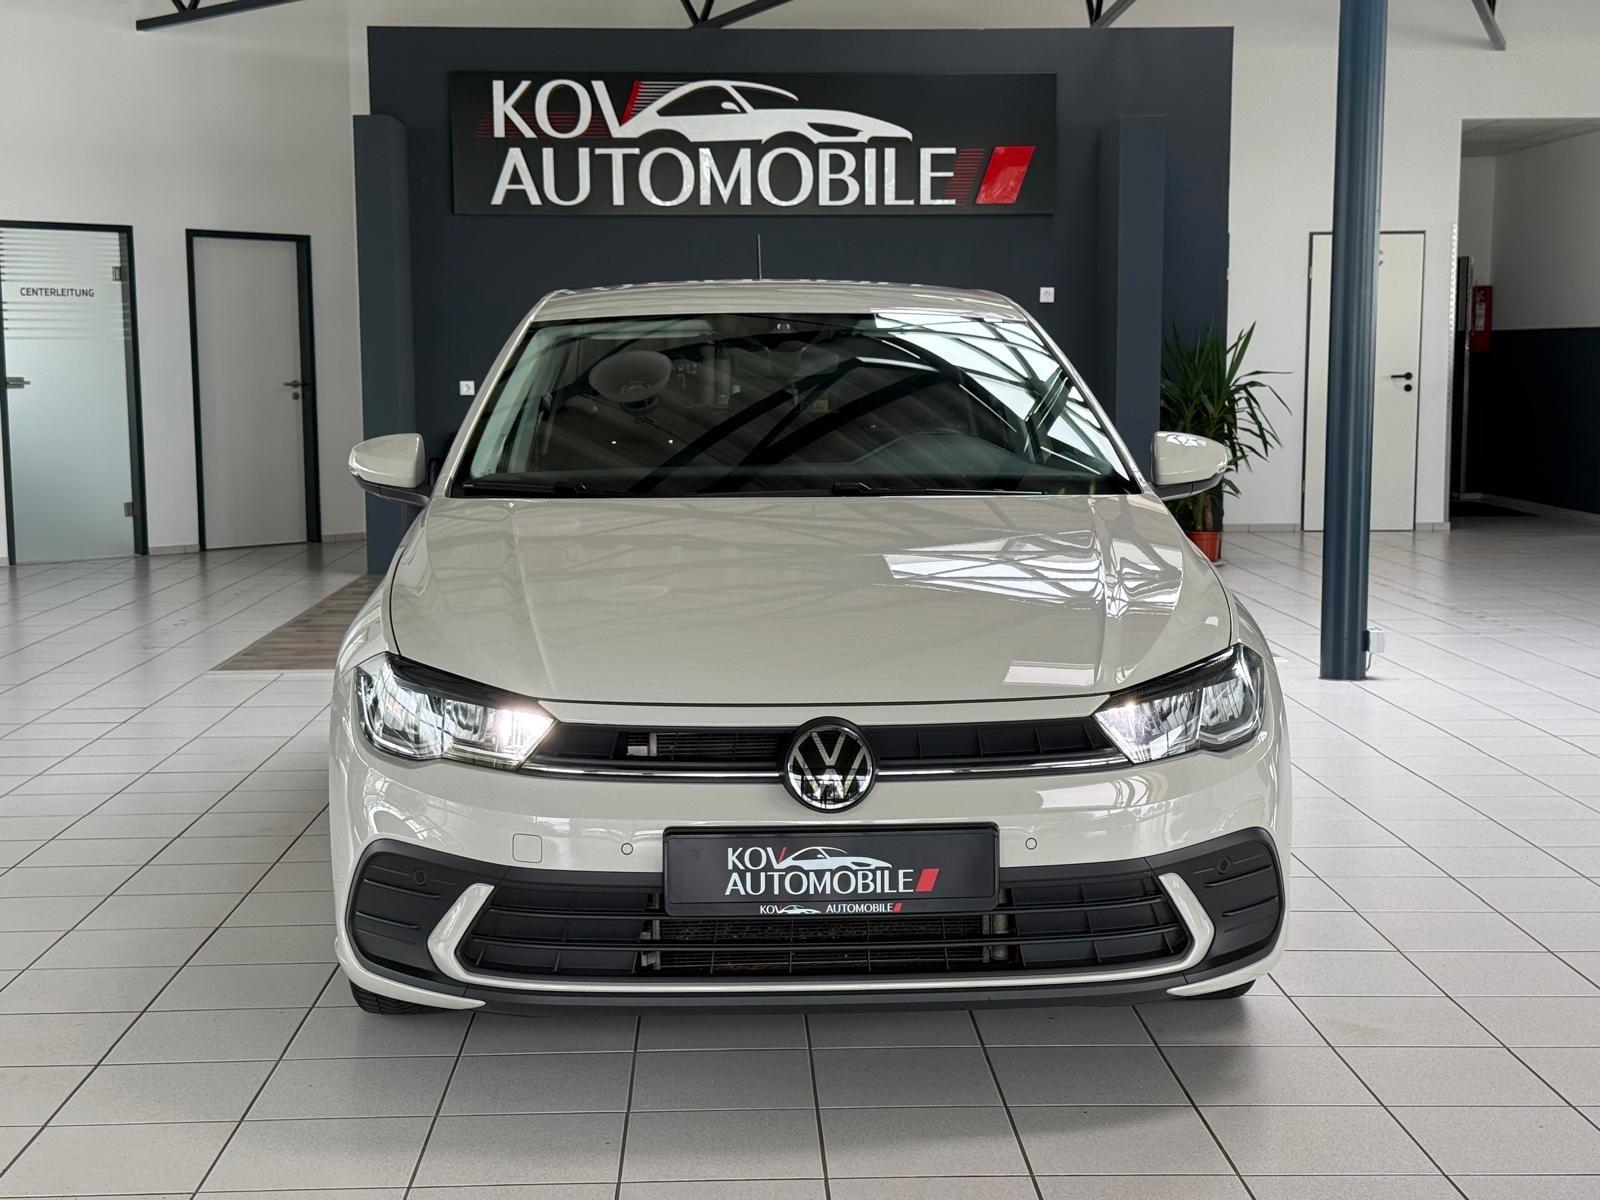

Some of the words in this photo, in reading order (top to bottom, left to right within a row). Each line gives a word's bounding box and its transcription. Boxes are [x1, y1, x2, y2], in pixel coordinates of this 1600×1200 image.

[491, 79, 642, 139] KOV
[490, 147, 957, 206] AUTOMOBILE
[20, 287, 95, 298] CENTERLEITUNG
[793, 731, 867, 800] VW
[727, 847, 786, 870] KOV
[724, 869, 914, 896] AUTOMOBILE
[759, 904, 784, 915] KOV
[825, 902, 894, 914] AUTOMOBILE
